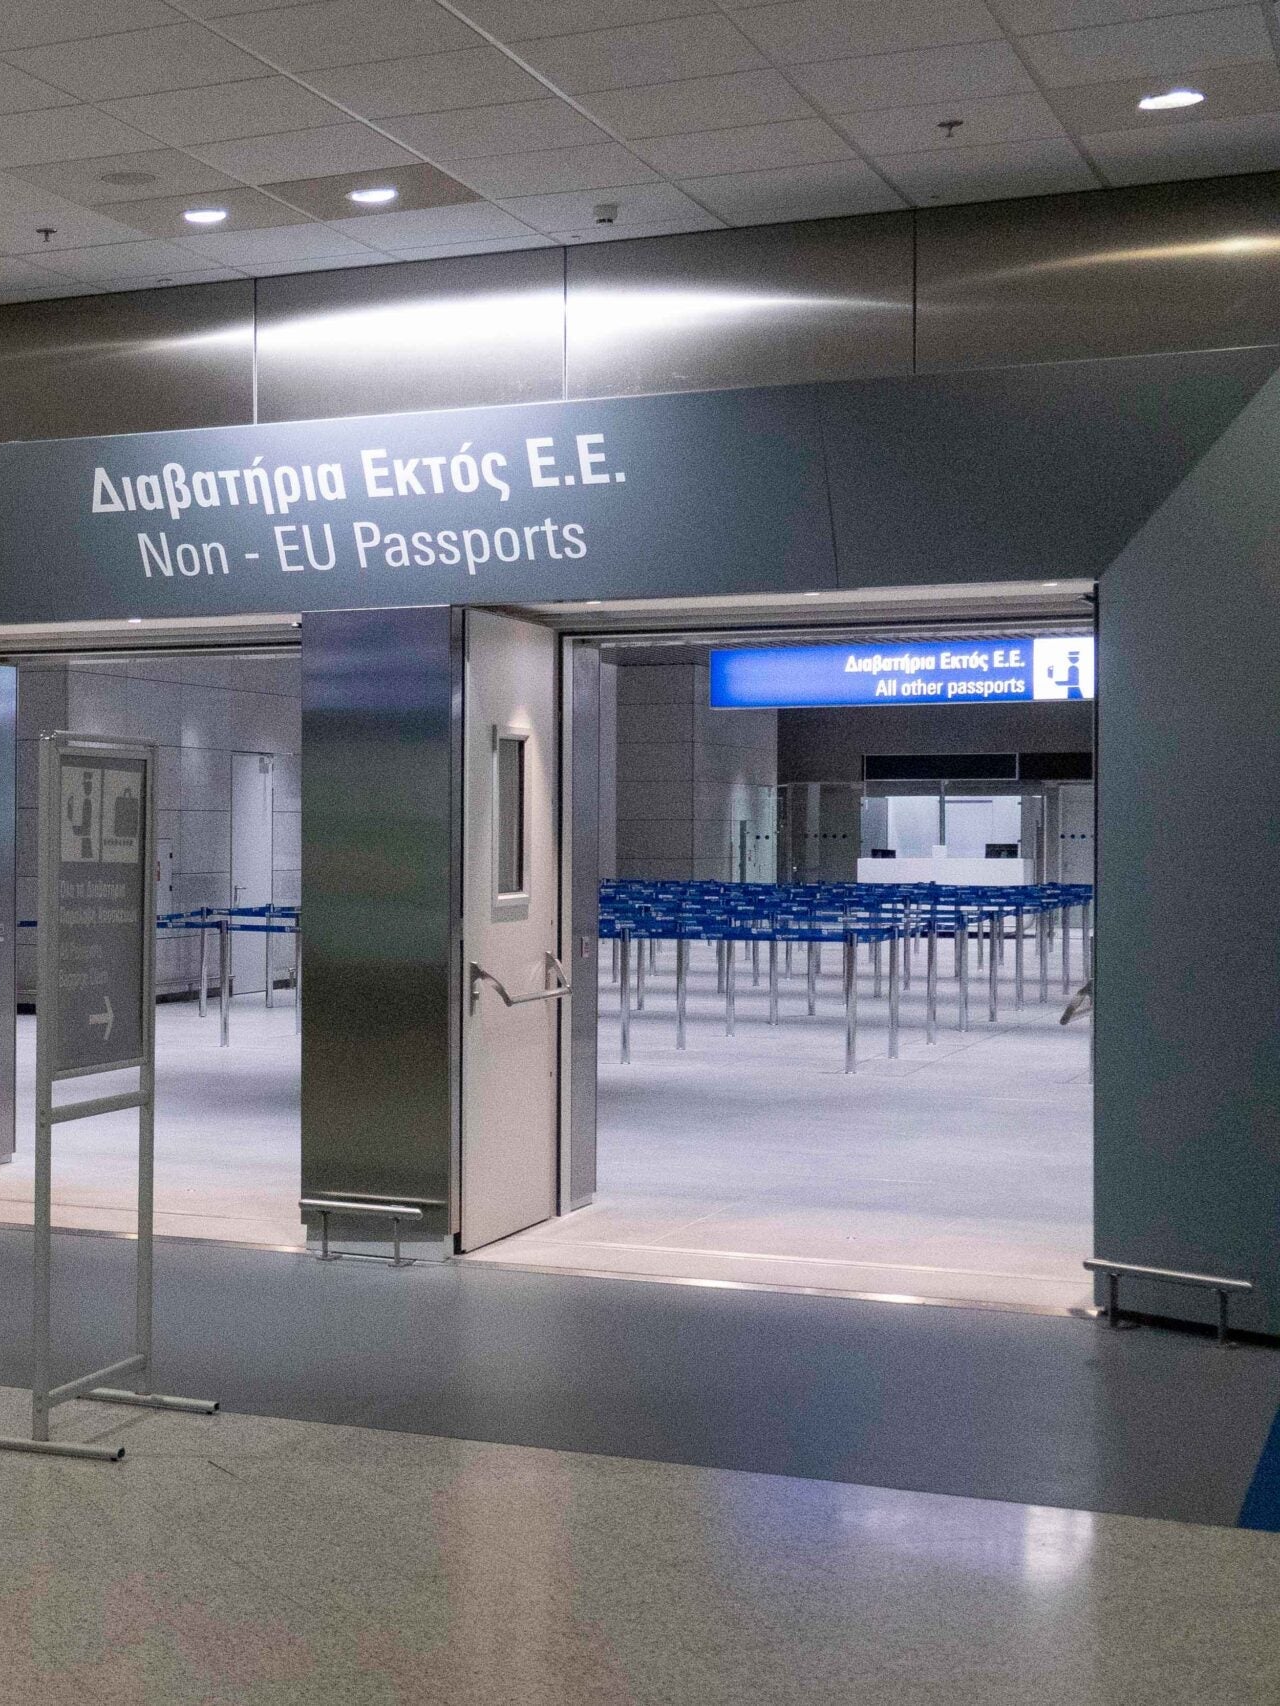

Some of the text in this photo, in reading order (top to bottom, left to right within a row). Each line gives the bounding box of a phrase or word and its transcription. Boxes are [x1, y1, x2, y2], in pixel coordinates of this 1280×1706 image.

[91, 455, 347, 520] Διαβατήρια
[361, 441, 510, 501] Εκτός
[137, 531, 229, 577] Non
[274, 523, 337, 572] EU
[353, 517, 588, 575] Passports
[845, 653, 935, 675] Διαβατήρια
[940, 651, 989, 671] Εκτός
[876, 678, 1025, 698] All other passports
